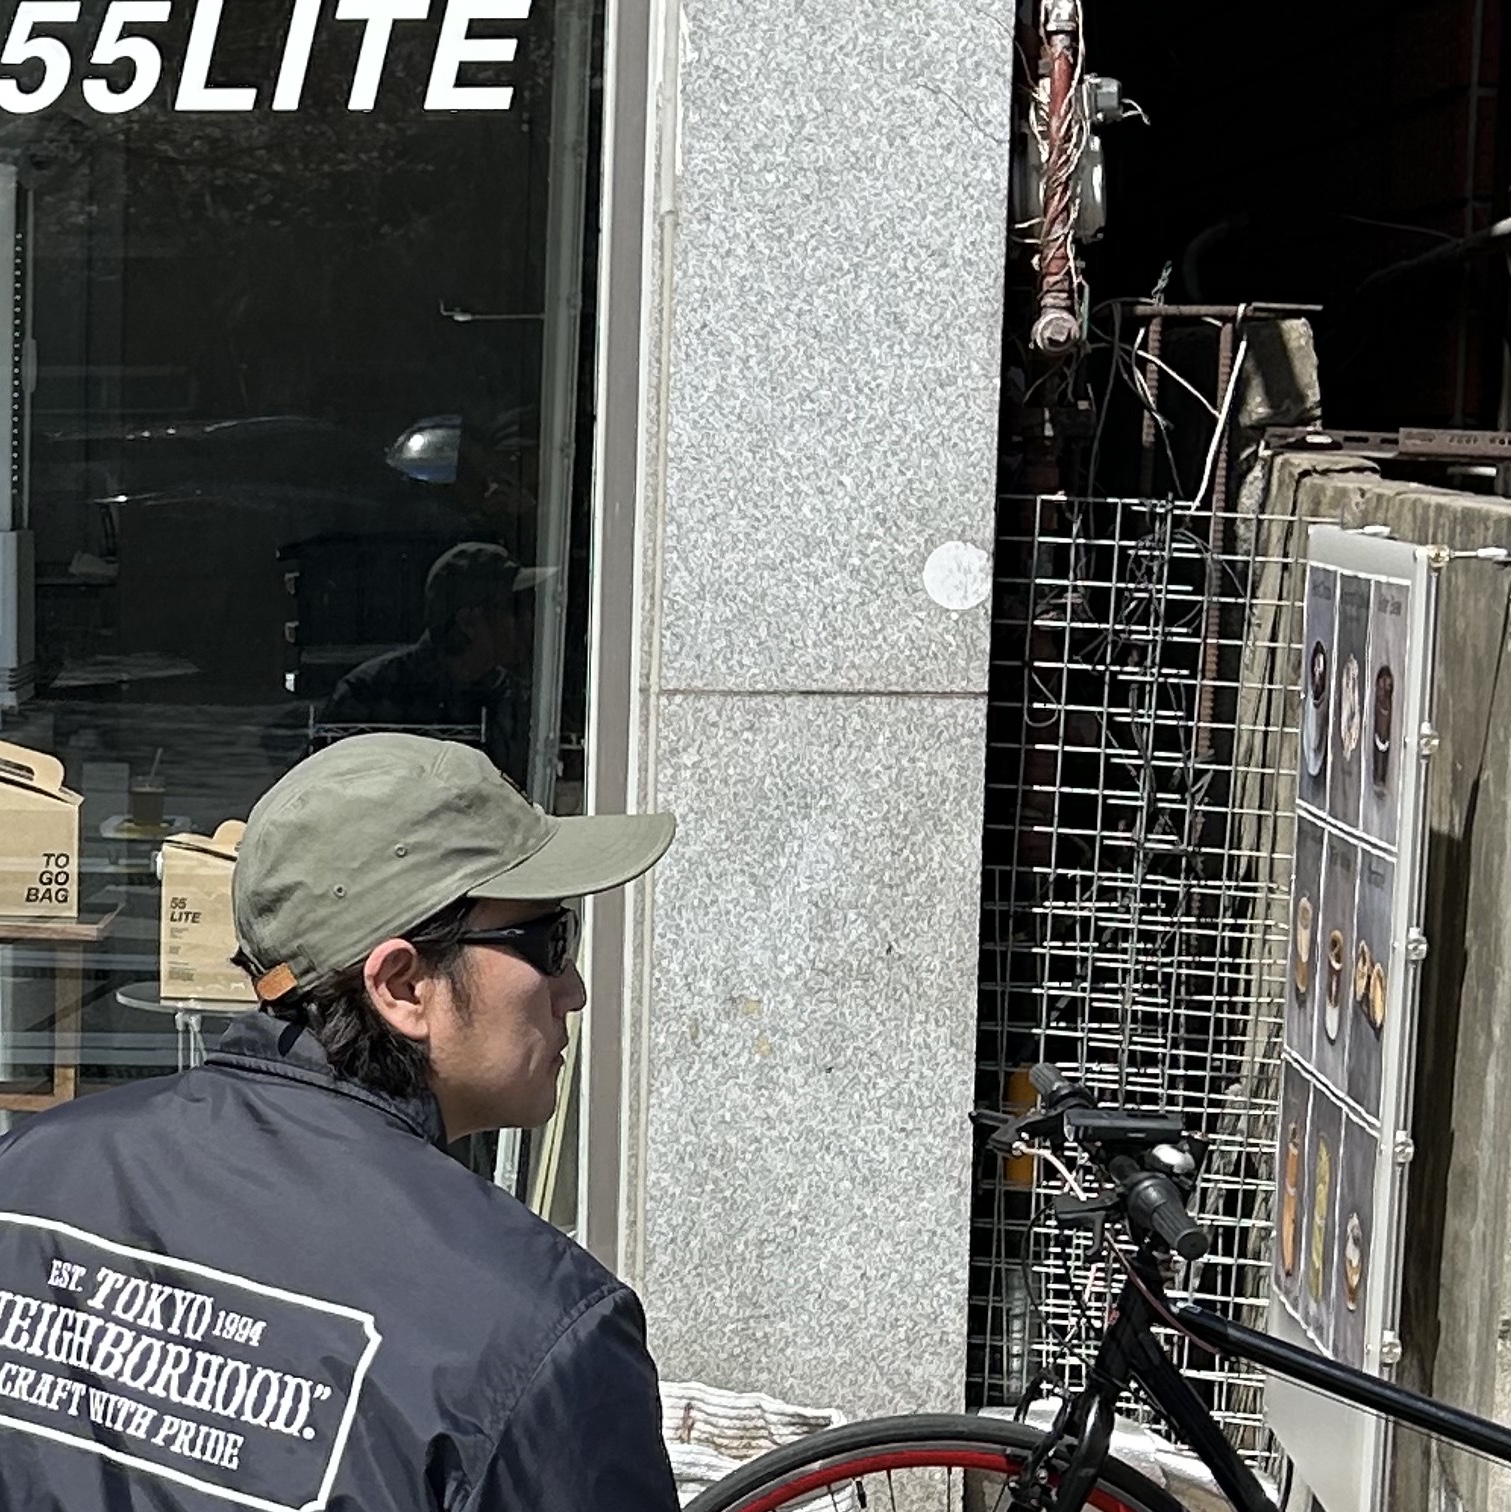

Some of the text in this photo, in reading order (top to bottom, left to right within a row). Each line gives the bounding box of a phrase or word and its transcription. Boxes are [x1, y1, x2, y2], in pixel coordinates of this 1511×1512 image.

[42, 853, 70, 869] TO
[38, 871, 70, 887] GO
[25, 888, 70, 904] BAG
[170, 897, 188, 910] 55
[170, 911, 202, 924] LITE
[47, 1259, 267, 1347] EST. TOKYO 1994
[88, 1386, 157, 1441] WITH
[157, 1417, 245, 1471] PRIDE
